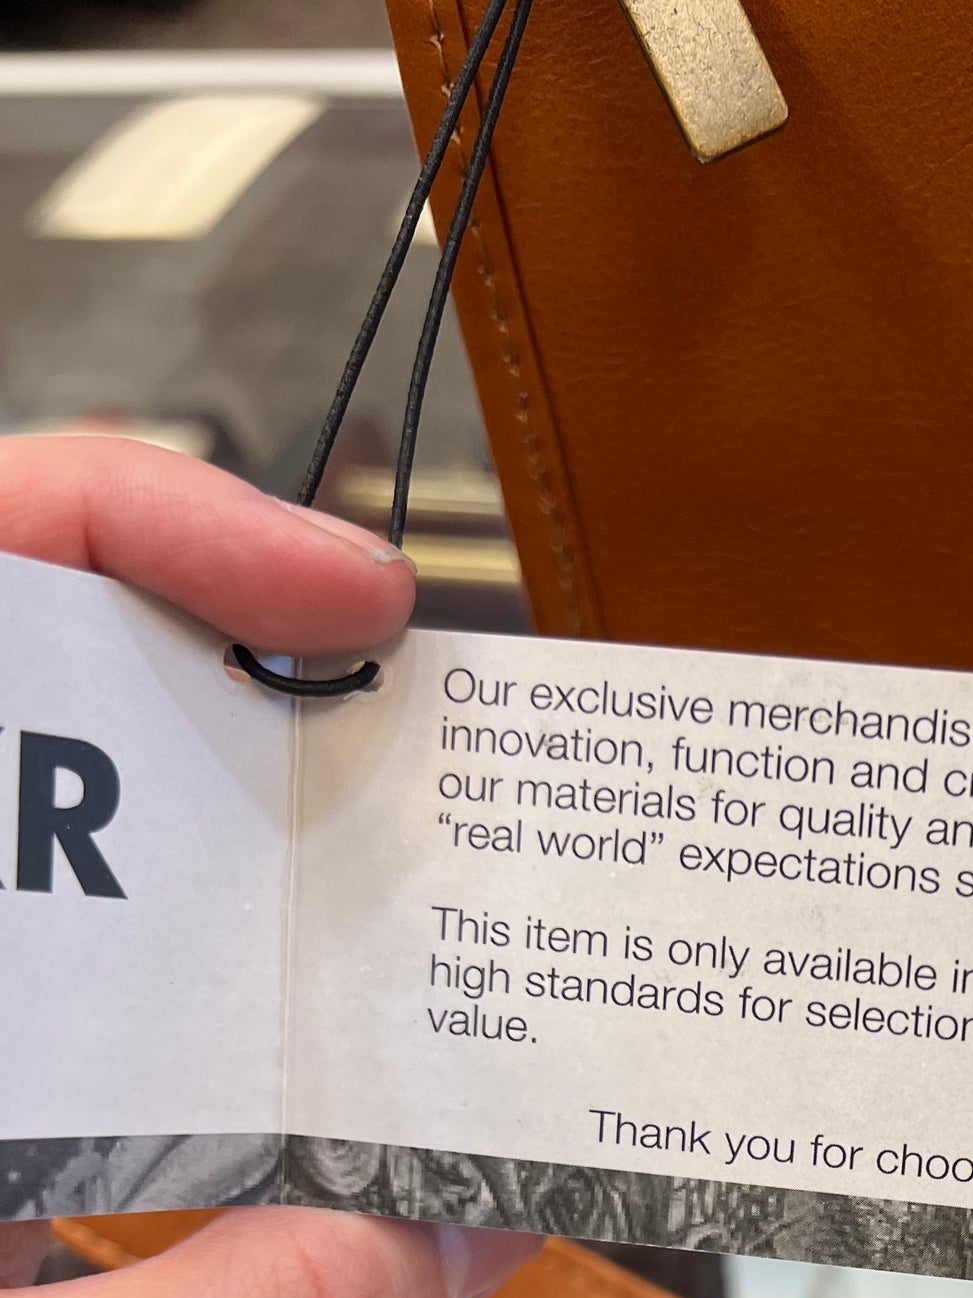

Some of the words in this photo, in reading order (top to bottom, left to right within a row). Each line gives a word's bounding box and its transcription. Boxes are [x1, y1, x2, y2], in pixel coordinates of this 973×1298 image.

[443, 667, 518, 707] Our
[529, 679, 714, 725] exclusive
[441, 715, 654, 775] innovation,
[671, 735, 835, 786] function
[850, 757, 929, 794] and
[0, 726, 129, 900] R
[438, 772, 504, 803] our
[517, 778, 696, 822] materials
[710, 788, 767, 828] for
[778, 801, 913, 850] quality
[438, 812, 523, 854] “real
[536, 827, 664, 866] world”
[679, 843, 941, 895] expectations
[431, 905, 511, 948] This
[525, 915, 608, 958] item
[624, 924, 653, 962] is
[668, 935, 751, 980] only
[763, 946, 938, 992] available
[426, 1003, 537, 1044] value.
[430, 952, 510, 1000] high
[524, 966, 724, 1017] standards
[738, 985, 794, 1024] for
[588, 1108, 713, 1156] Thank
[724, 1132, 796, 1166] you
[810, 1133, 864, 1171] for
